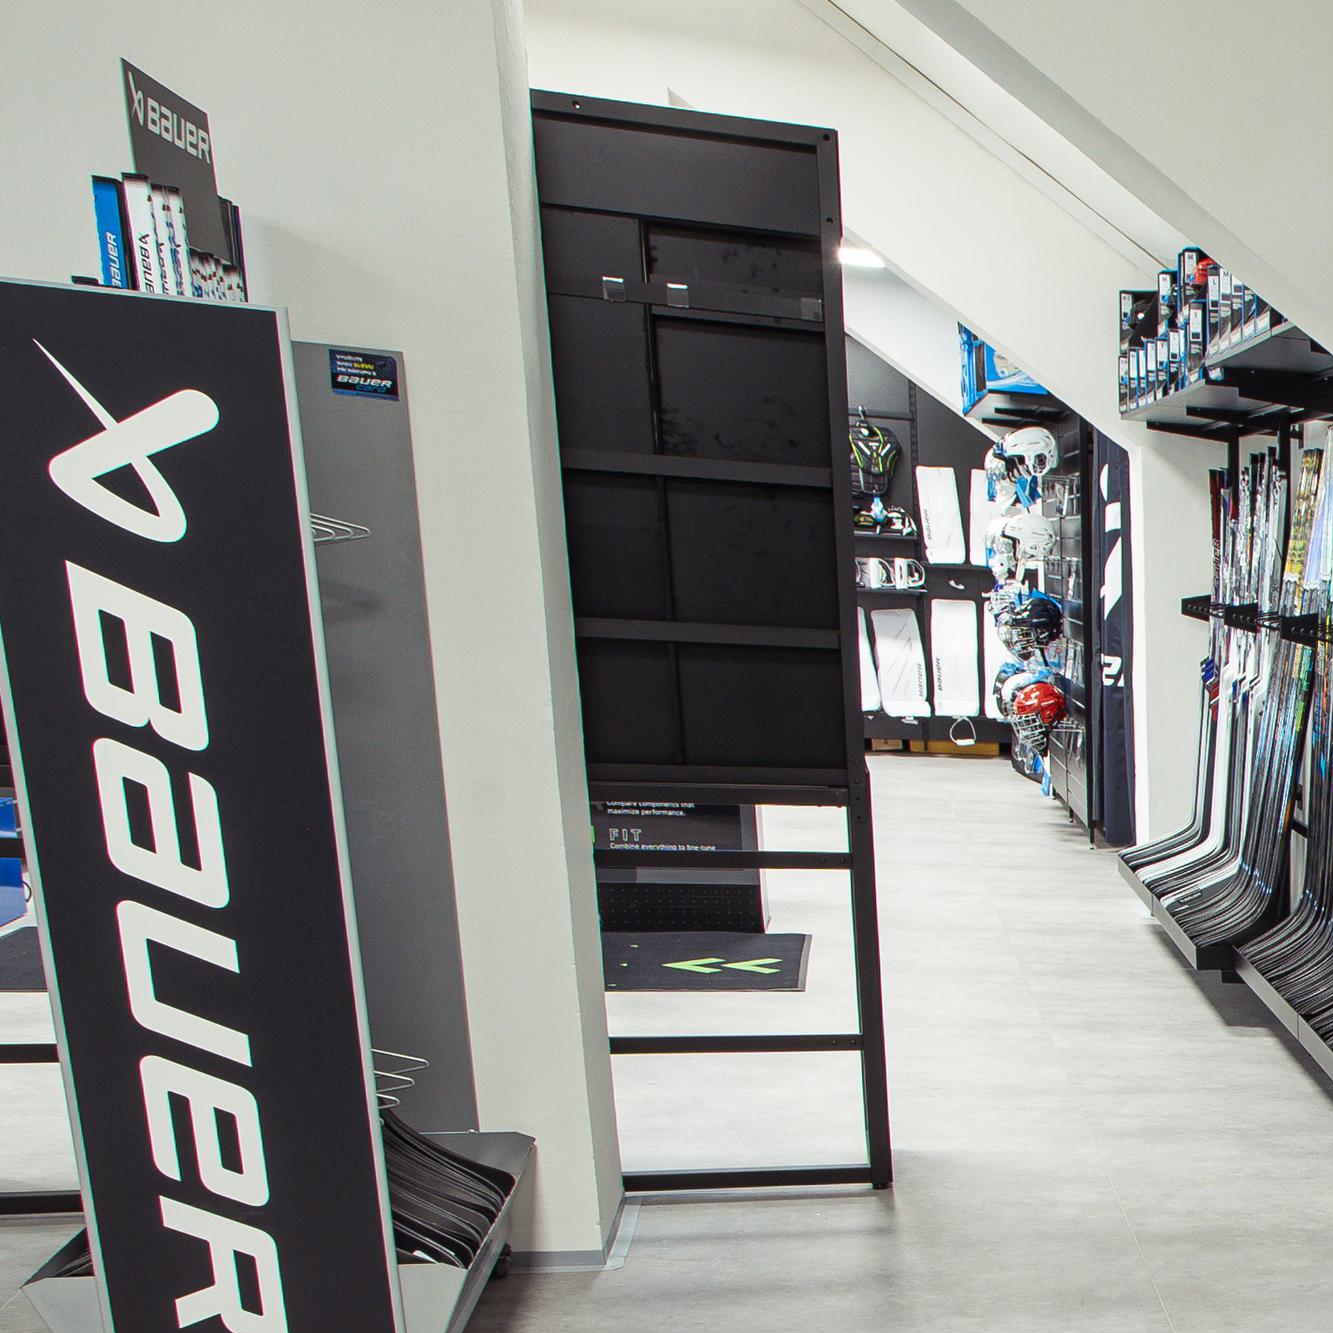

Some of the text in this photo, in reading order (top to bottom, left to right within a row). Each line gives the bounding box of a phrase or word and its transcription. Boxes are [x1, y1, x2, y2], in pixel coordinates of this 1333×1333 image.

[147, 96, 211, 165] BAUER
[140, 246, 155, 294] BAUE
[336, 374, 393, 388] BAUER
[609, 828, 642, 841] FIT
